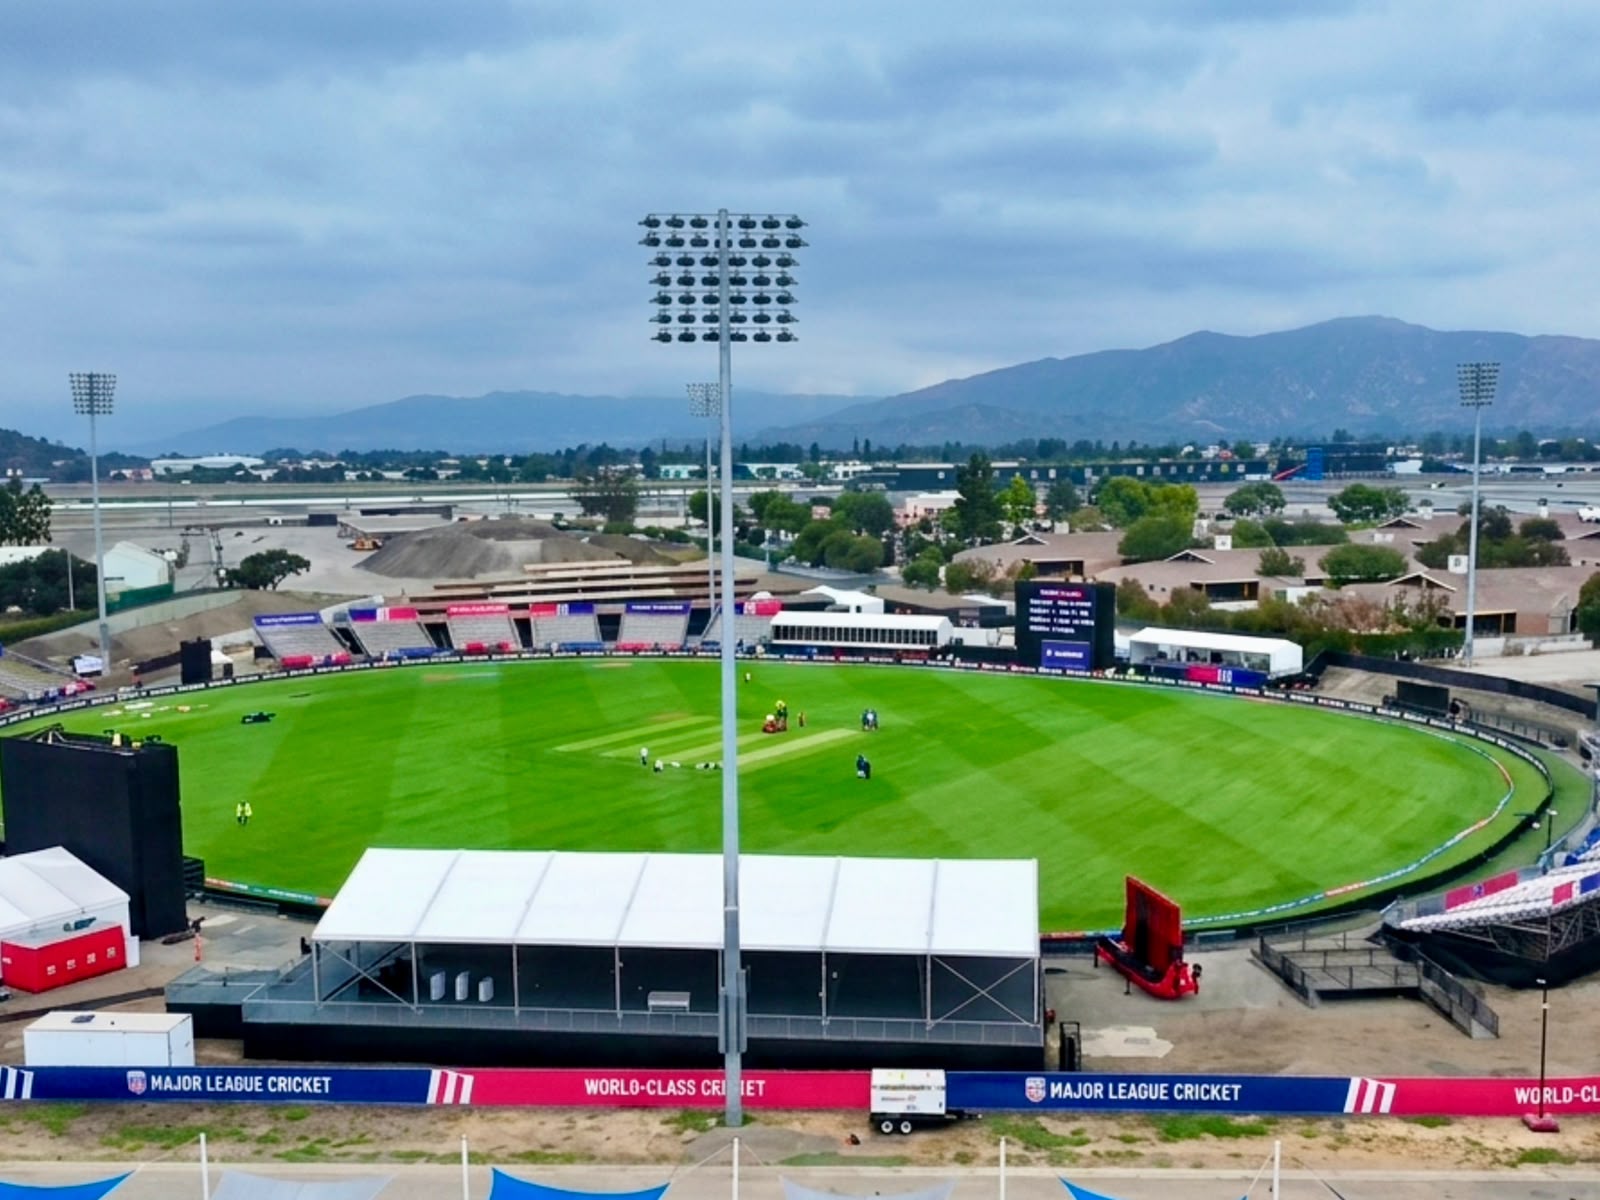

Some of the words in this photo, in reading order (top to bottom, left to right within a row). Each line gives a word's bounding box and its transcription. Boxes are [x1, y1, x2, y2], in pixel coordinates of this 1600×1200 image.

[150, 1074, 203, 1092] MAJOR
[205, 1075, 264, 1092] LEAGUE
[267, 1076, 332, 1094] CRICKET
[584, 1078, 697, 1096] WORLD-CLASS
[700, 1078, 766, 1097] CRIET
[1049, 1082, 1104, 1100] MAJOR
[1108, 1082, 1169, 1101] LEAGUE
[1173, 1083, 1243, 1101] CRICKET
